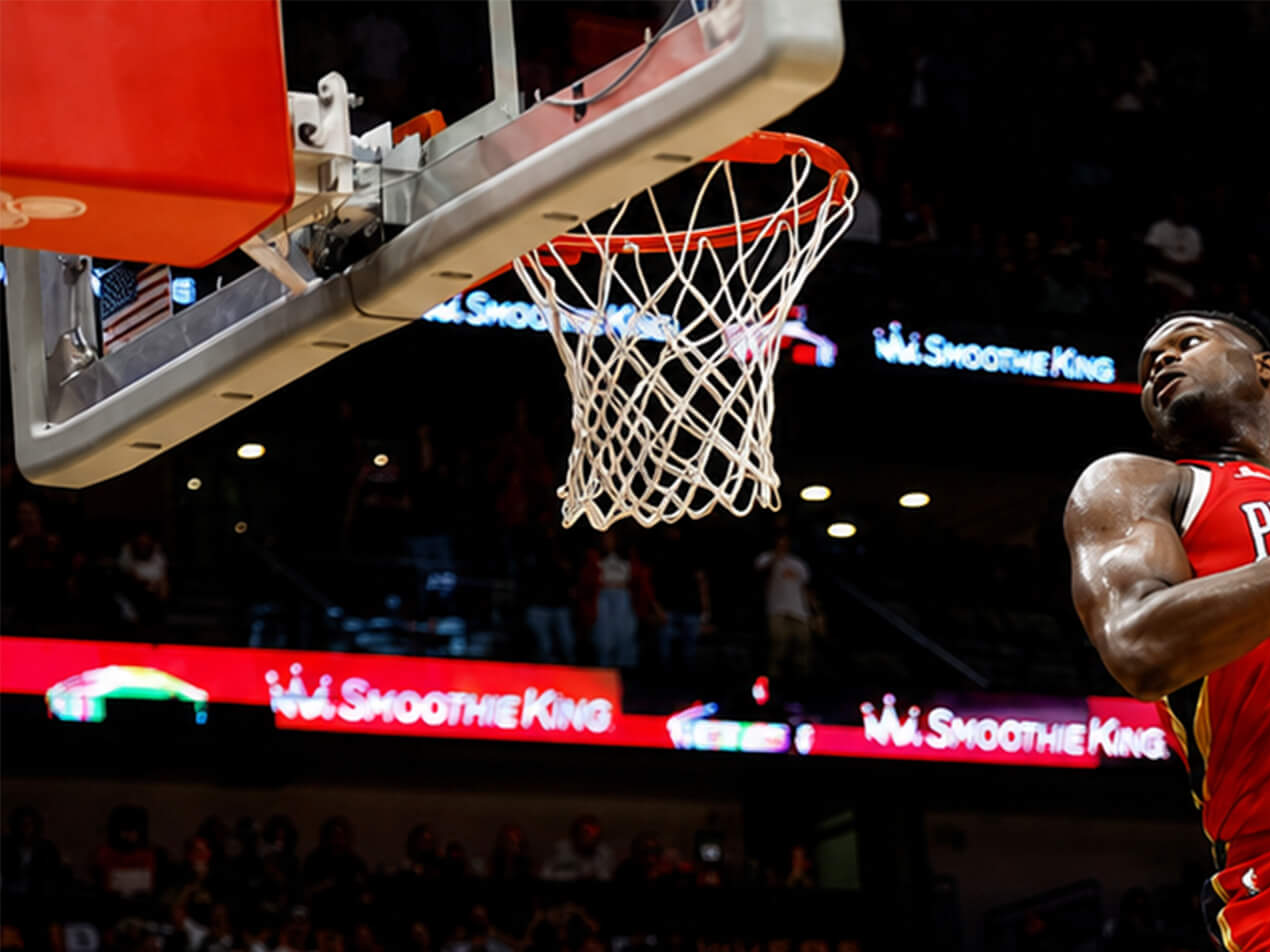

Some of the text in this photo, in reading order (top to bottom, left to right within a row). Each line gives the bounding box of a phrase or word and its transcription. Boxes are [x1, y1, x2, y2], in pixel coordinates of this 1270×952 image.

[465, 290, 605, 336] SMOO
[923, 334, 1115, 383] SMOOTHIE KING
[336, 677, 613, 733] SMOOTHIE KING
[925, 708, 1167, 760] SMOOTHIE KING
